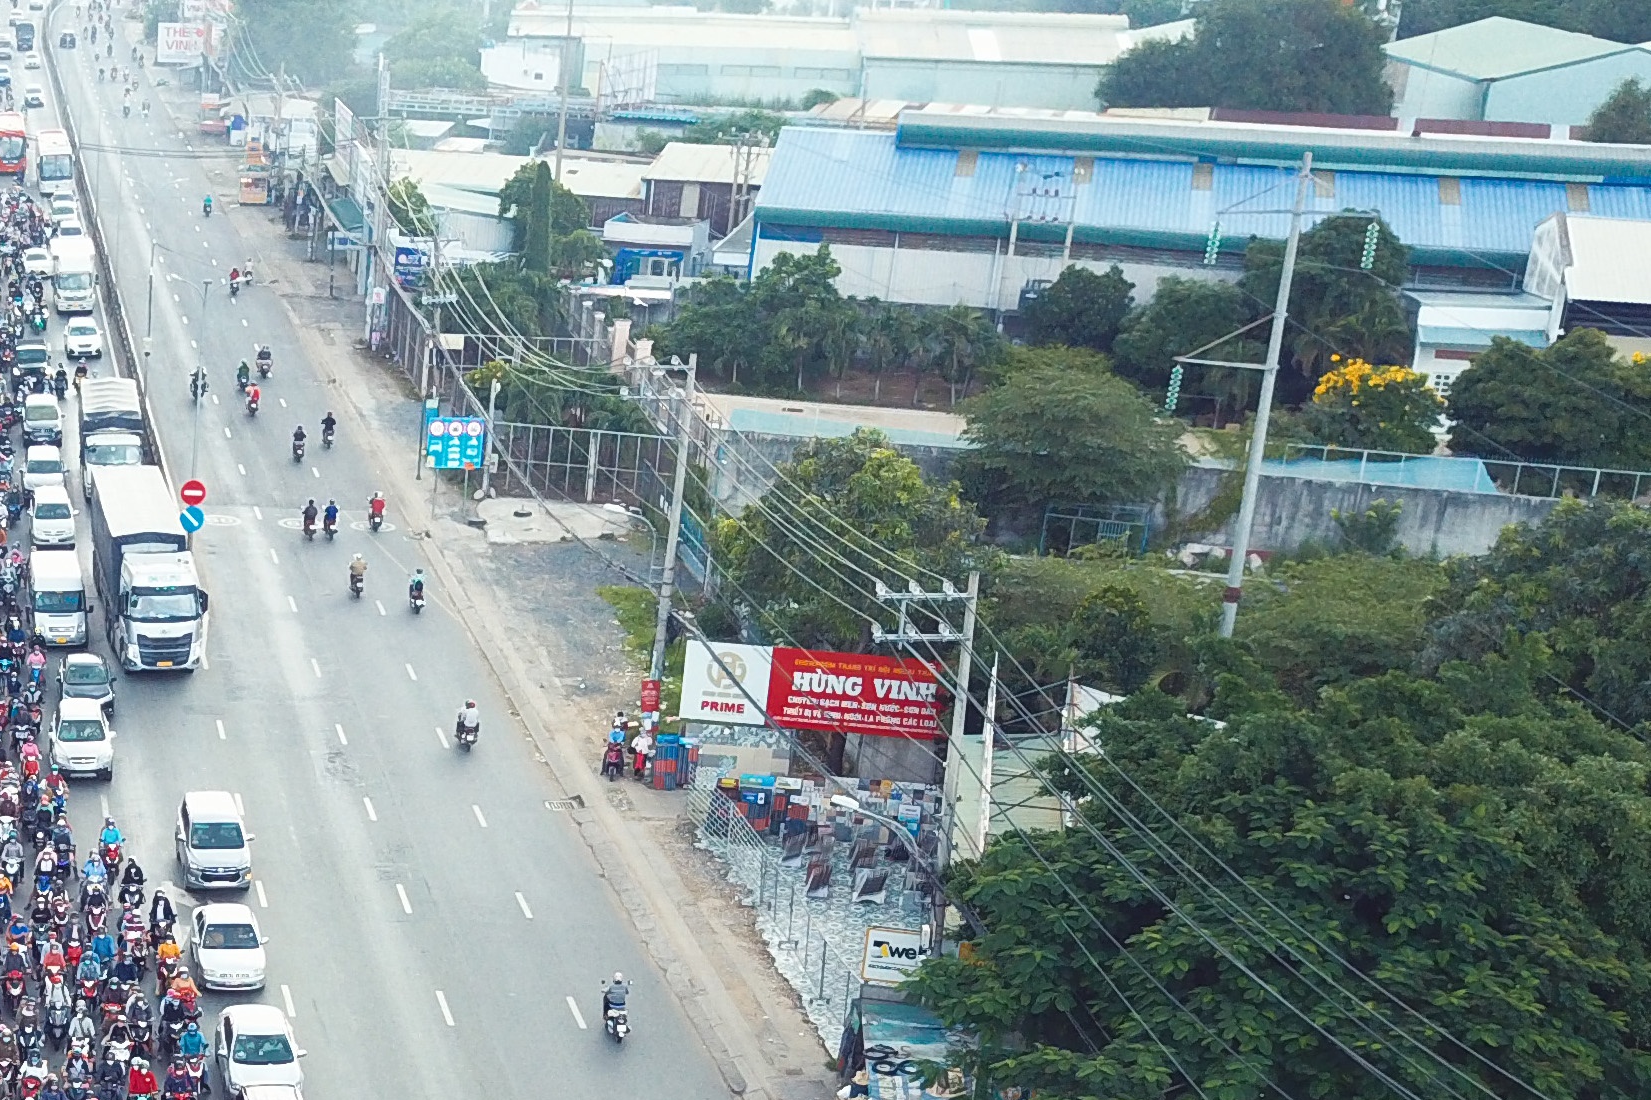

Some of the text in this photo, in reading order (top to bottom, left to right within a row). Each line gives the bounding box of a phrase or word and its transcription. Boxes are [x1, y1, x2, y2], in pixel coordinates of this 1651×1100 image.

[792, 669, 938, 703] HÙNG VINH
[701, 701, 745, 714] PRIME
